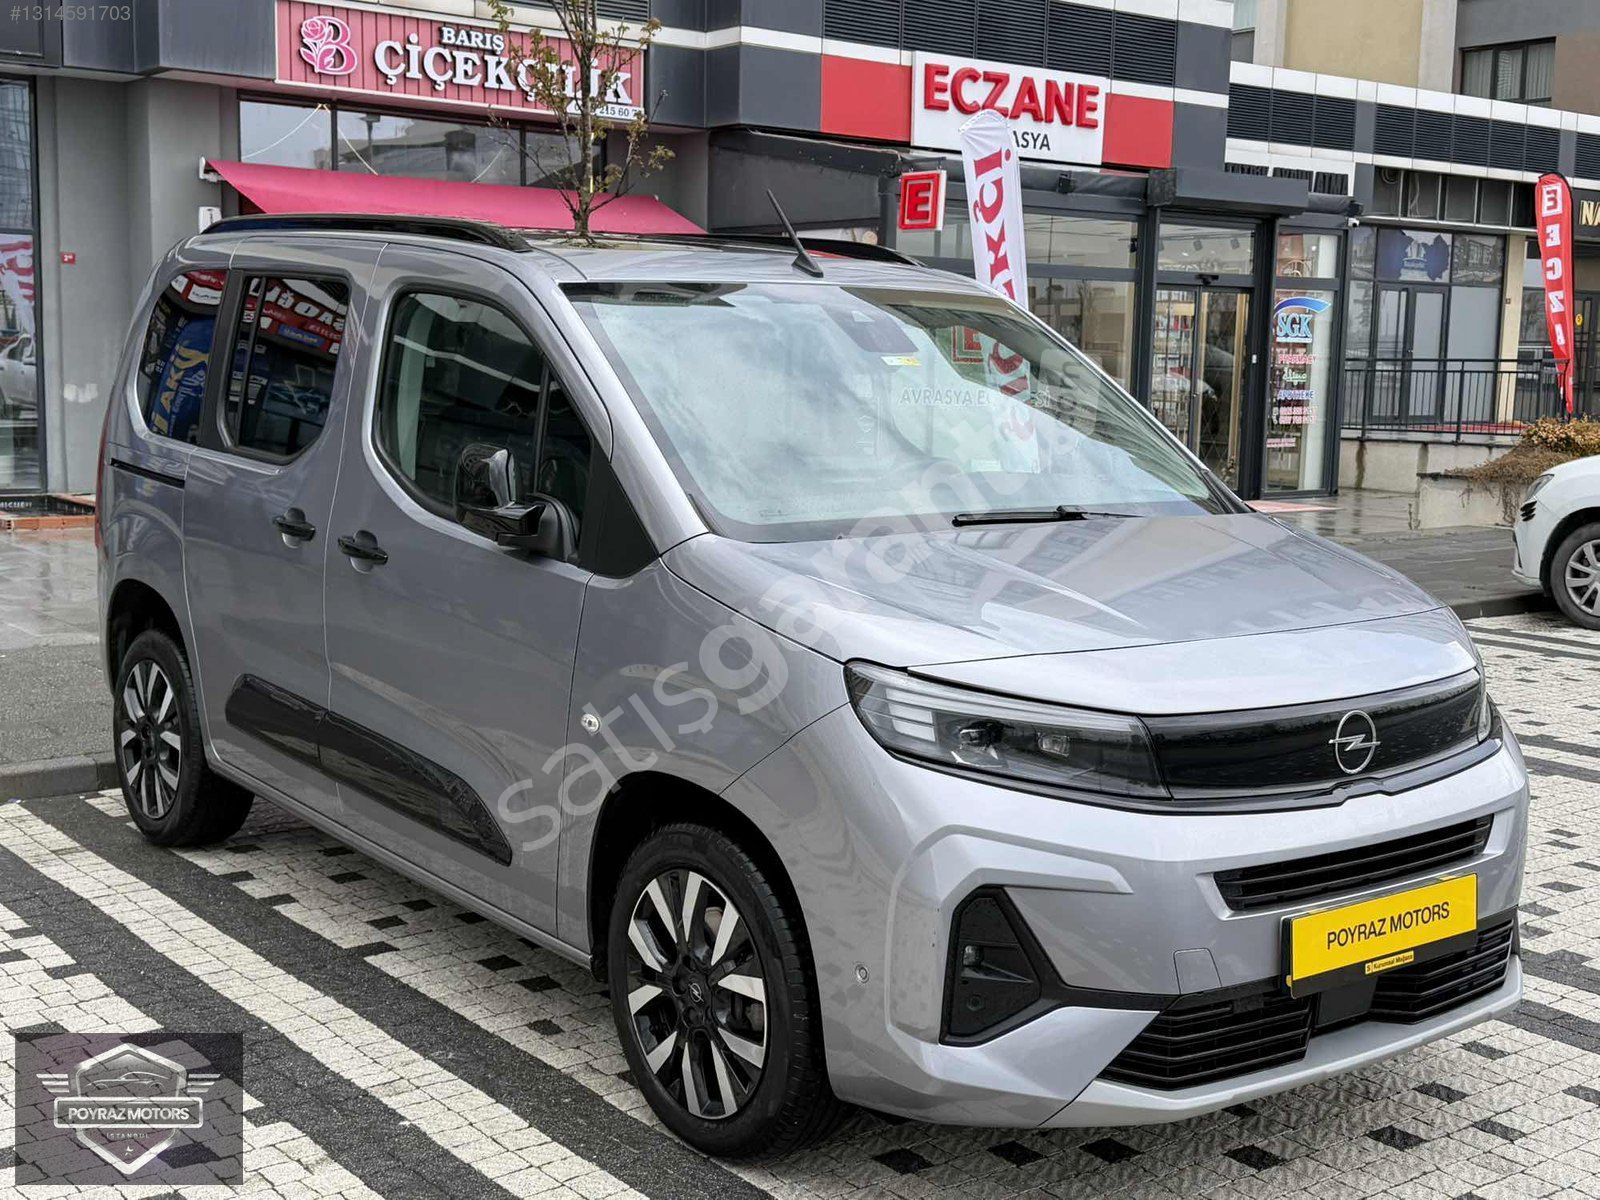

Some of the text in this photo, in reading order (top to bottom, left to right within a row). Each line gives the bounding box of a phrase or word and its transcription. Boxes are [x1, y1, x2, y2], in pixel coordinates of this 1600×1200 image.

[441, 27, 504, 54] BARIŞ
[924, 62, 1100, 129] ECZANE
[907, 182, 931, 220] E
[1276, 313, 1313, 337] SGK
[900, 389, 971, 405] AVRASYA
[1327, 901, 1450, 950] POYRAZ MOTORS
